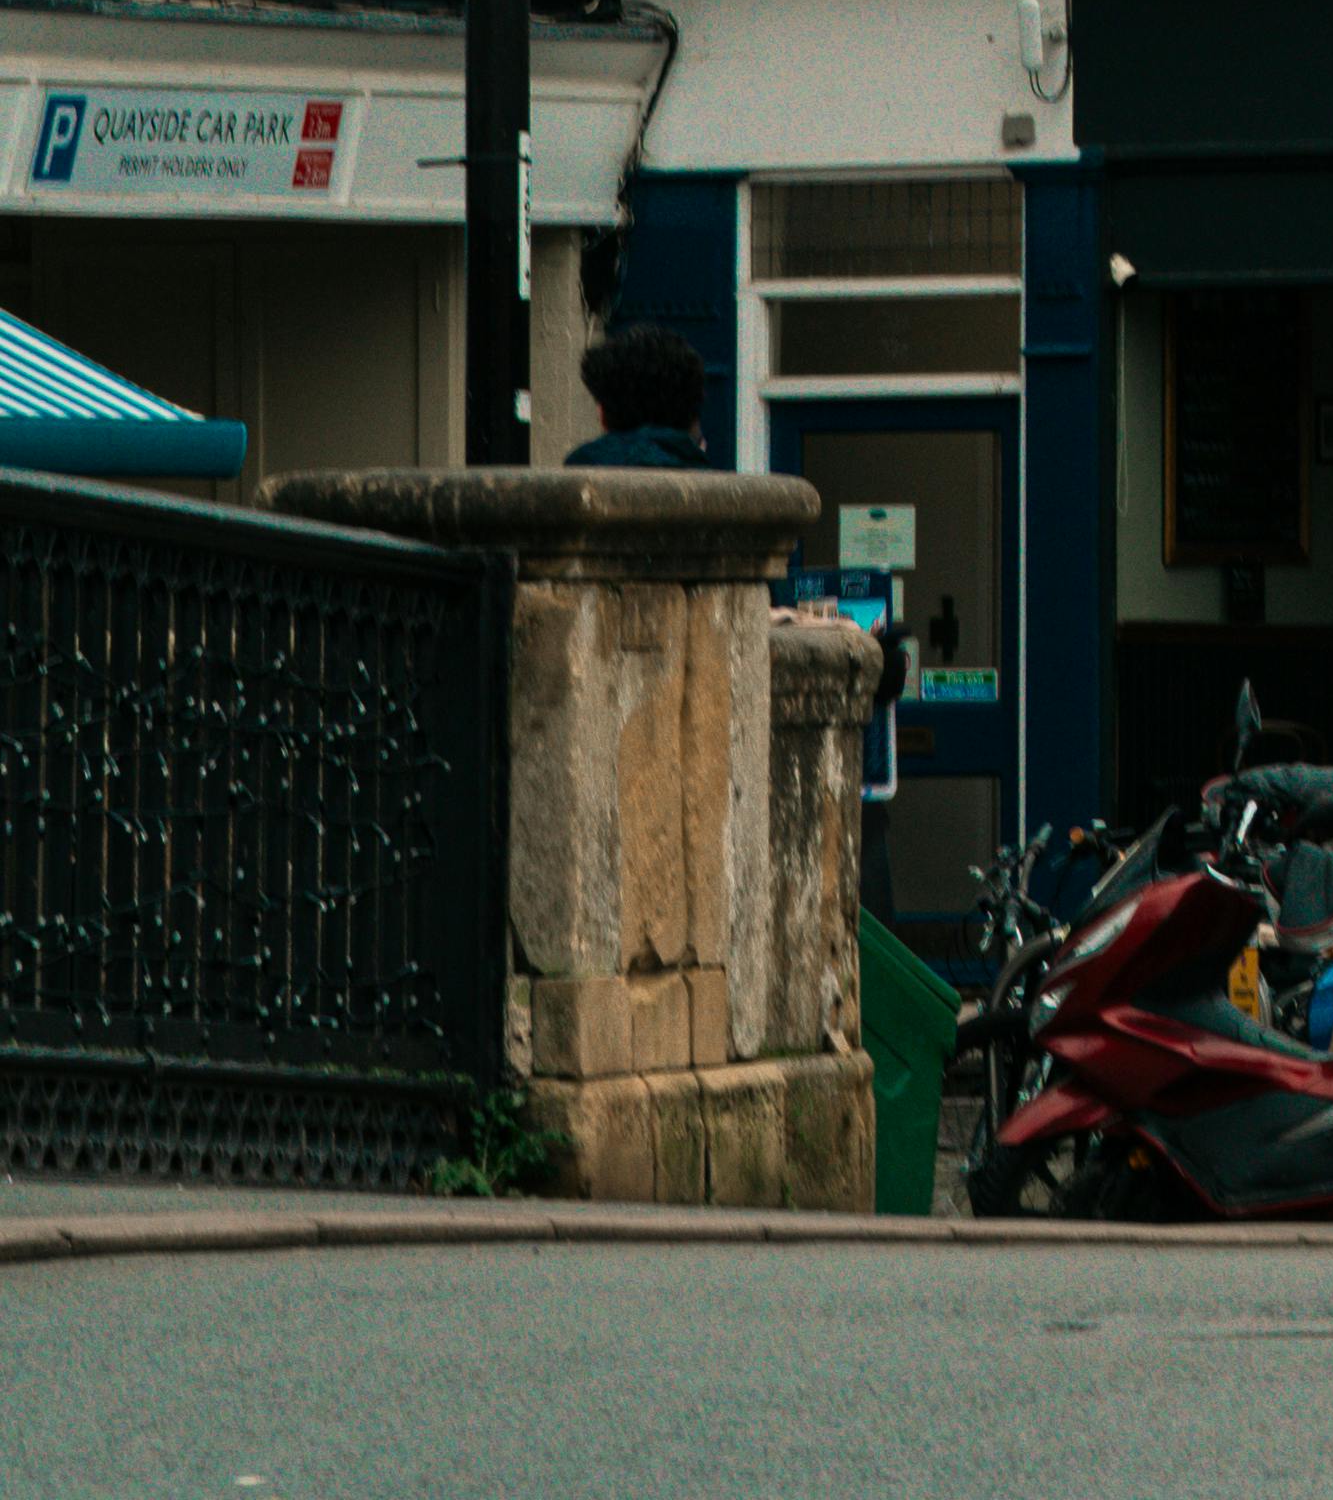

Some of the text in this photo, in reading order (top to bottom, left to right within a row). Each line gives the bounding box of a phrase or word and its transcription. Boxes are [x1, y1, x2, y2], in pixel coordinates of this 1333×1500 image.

[43, 104, 77, 175] P
[93, 106, 192, 145] QUAYSIDE
[197, 108, 238, 143] CAR
[244, 109, 294, 146] PARK
[118, 154, 249, 178] PERMIT HOLDERS ONLY
